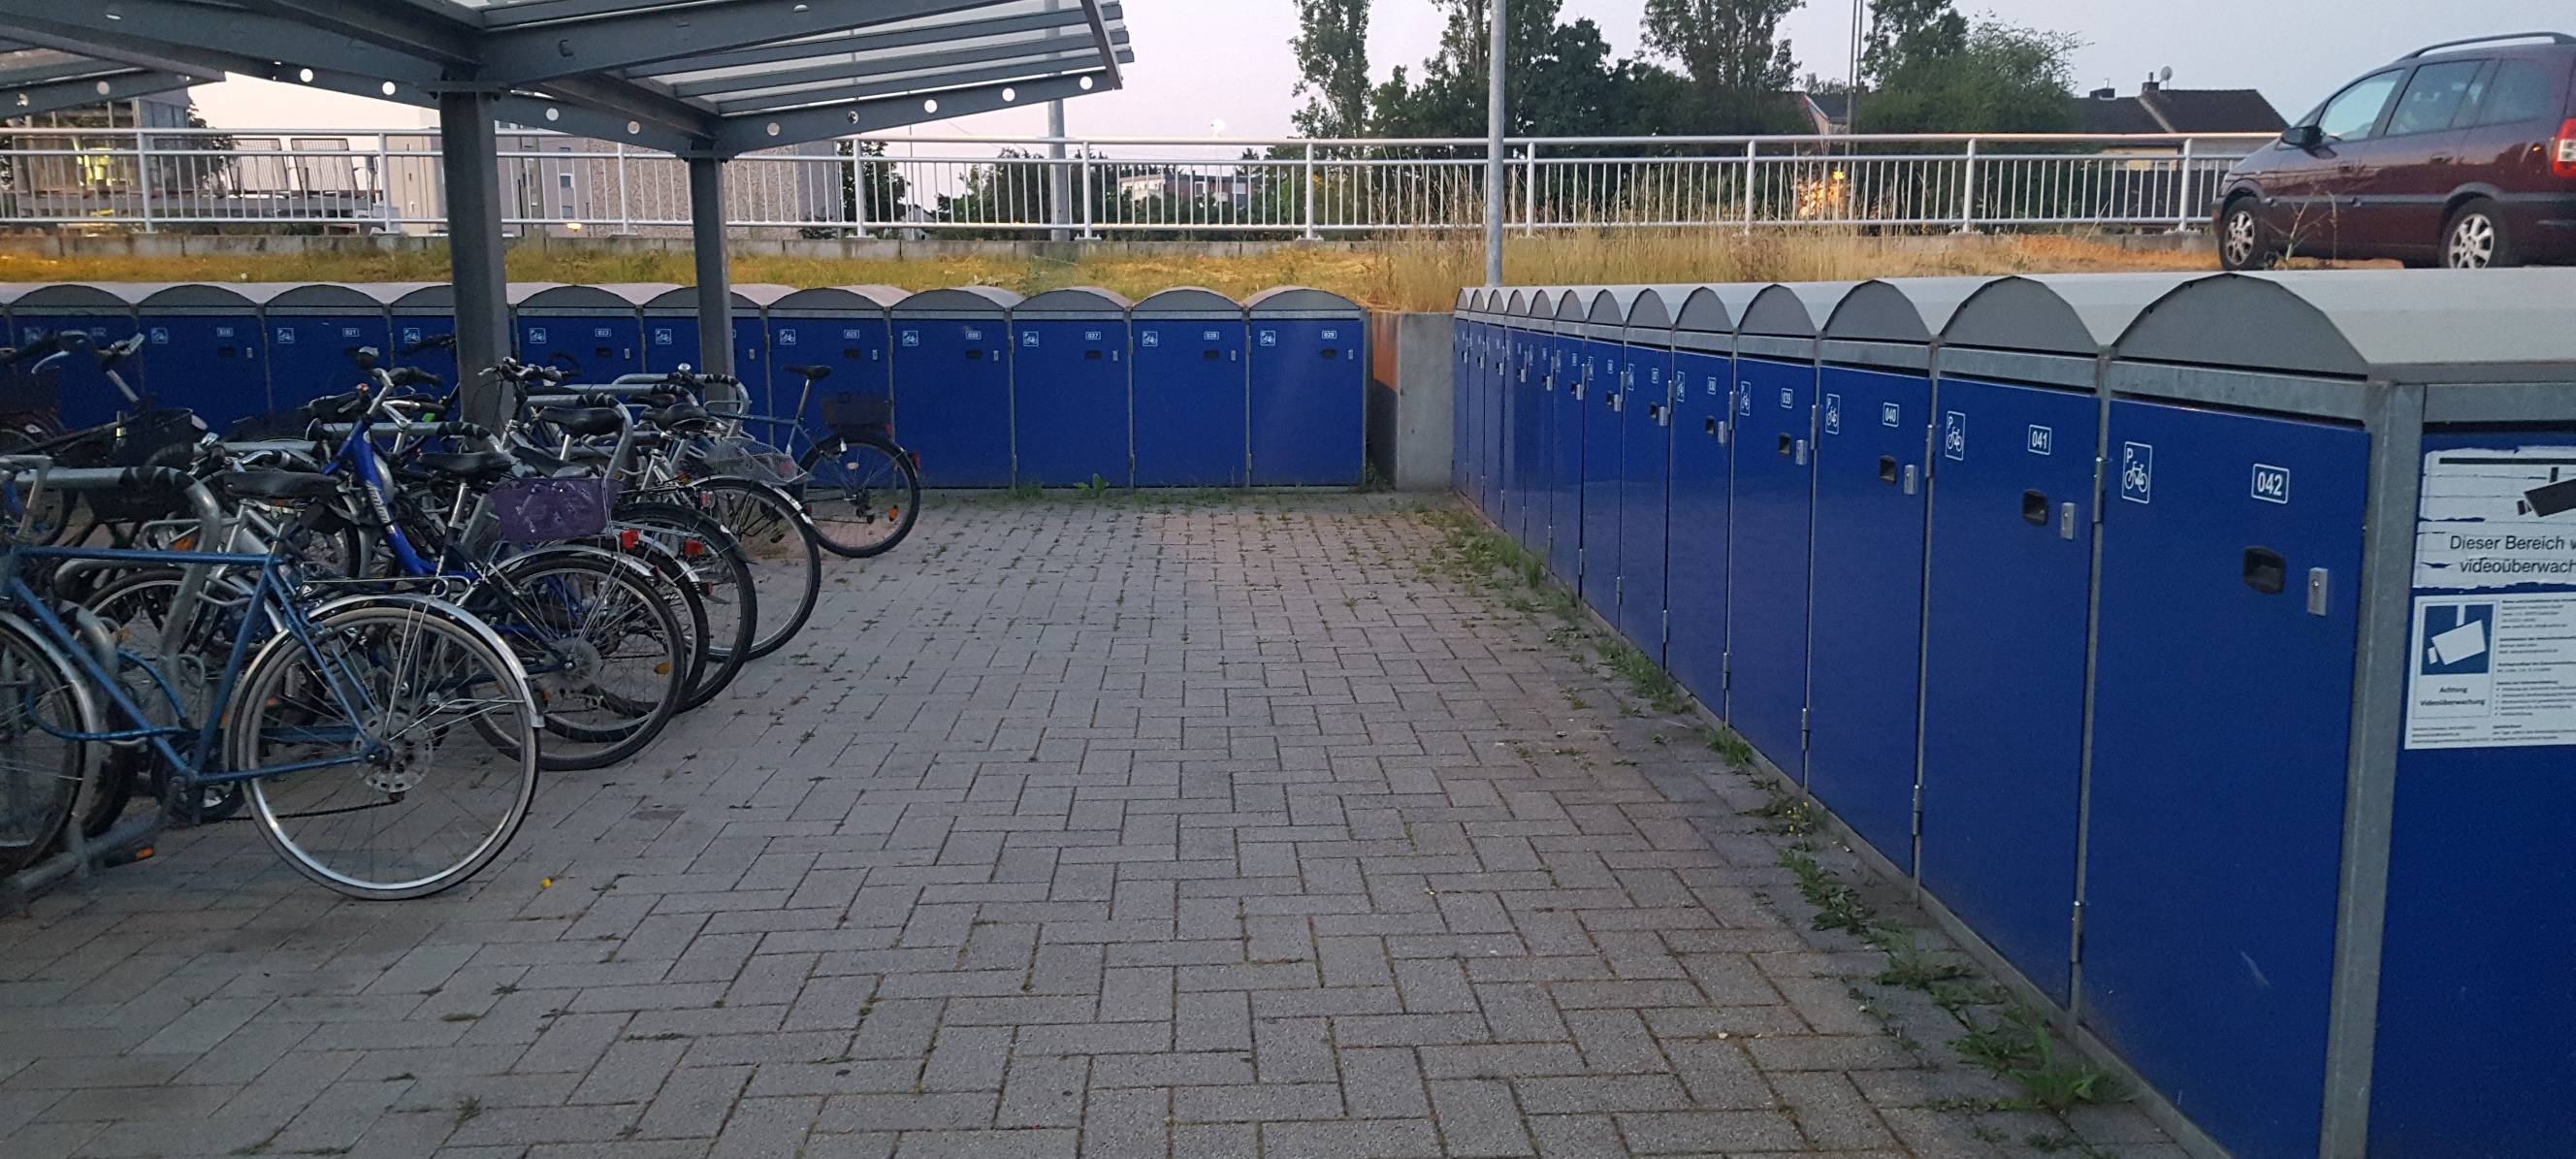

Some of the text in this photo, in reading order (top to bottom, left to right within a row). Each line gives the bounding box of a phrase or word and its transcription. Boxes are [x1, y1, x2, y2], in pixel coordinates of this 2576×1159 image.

[1884, 407, 1897, 423] 040
[2032, 431, 2047, 450] 041
[2126, 448, 2134, 463] P
[2257, 471, 2283, 497] 042
[2450, 535, 2501, 550] Dieser
[2505, 535, 2564, 550] Bereich
